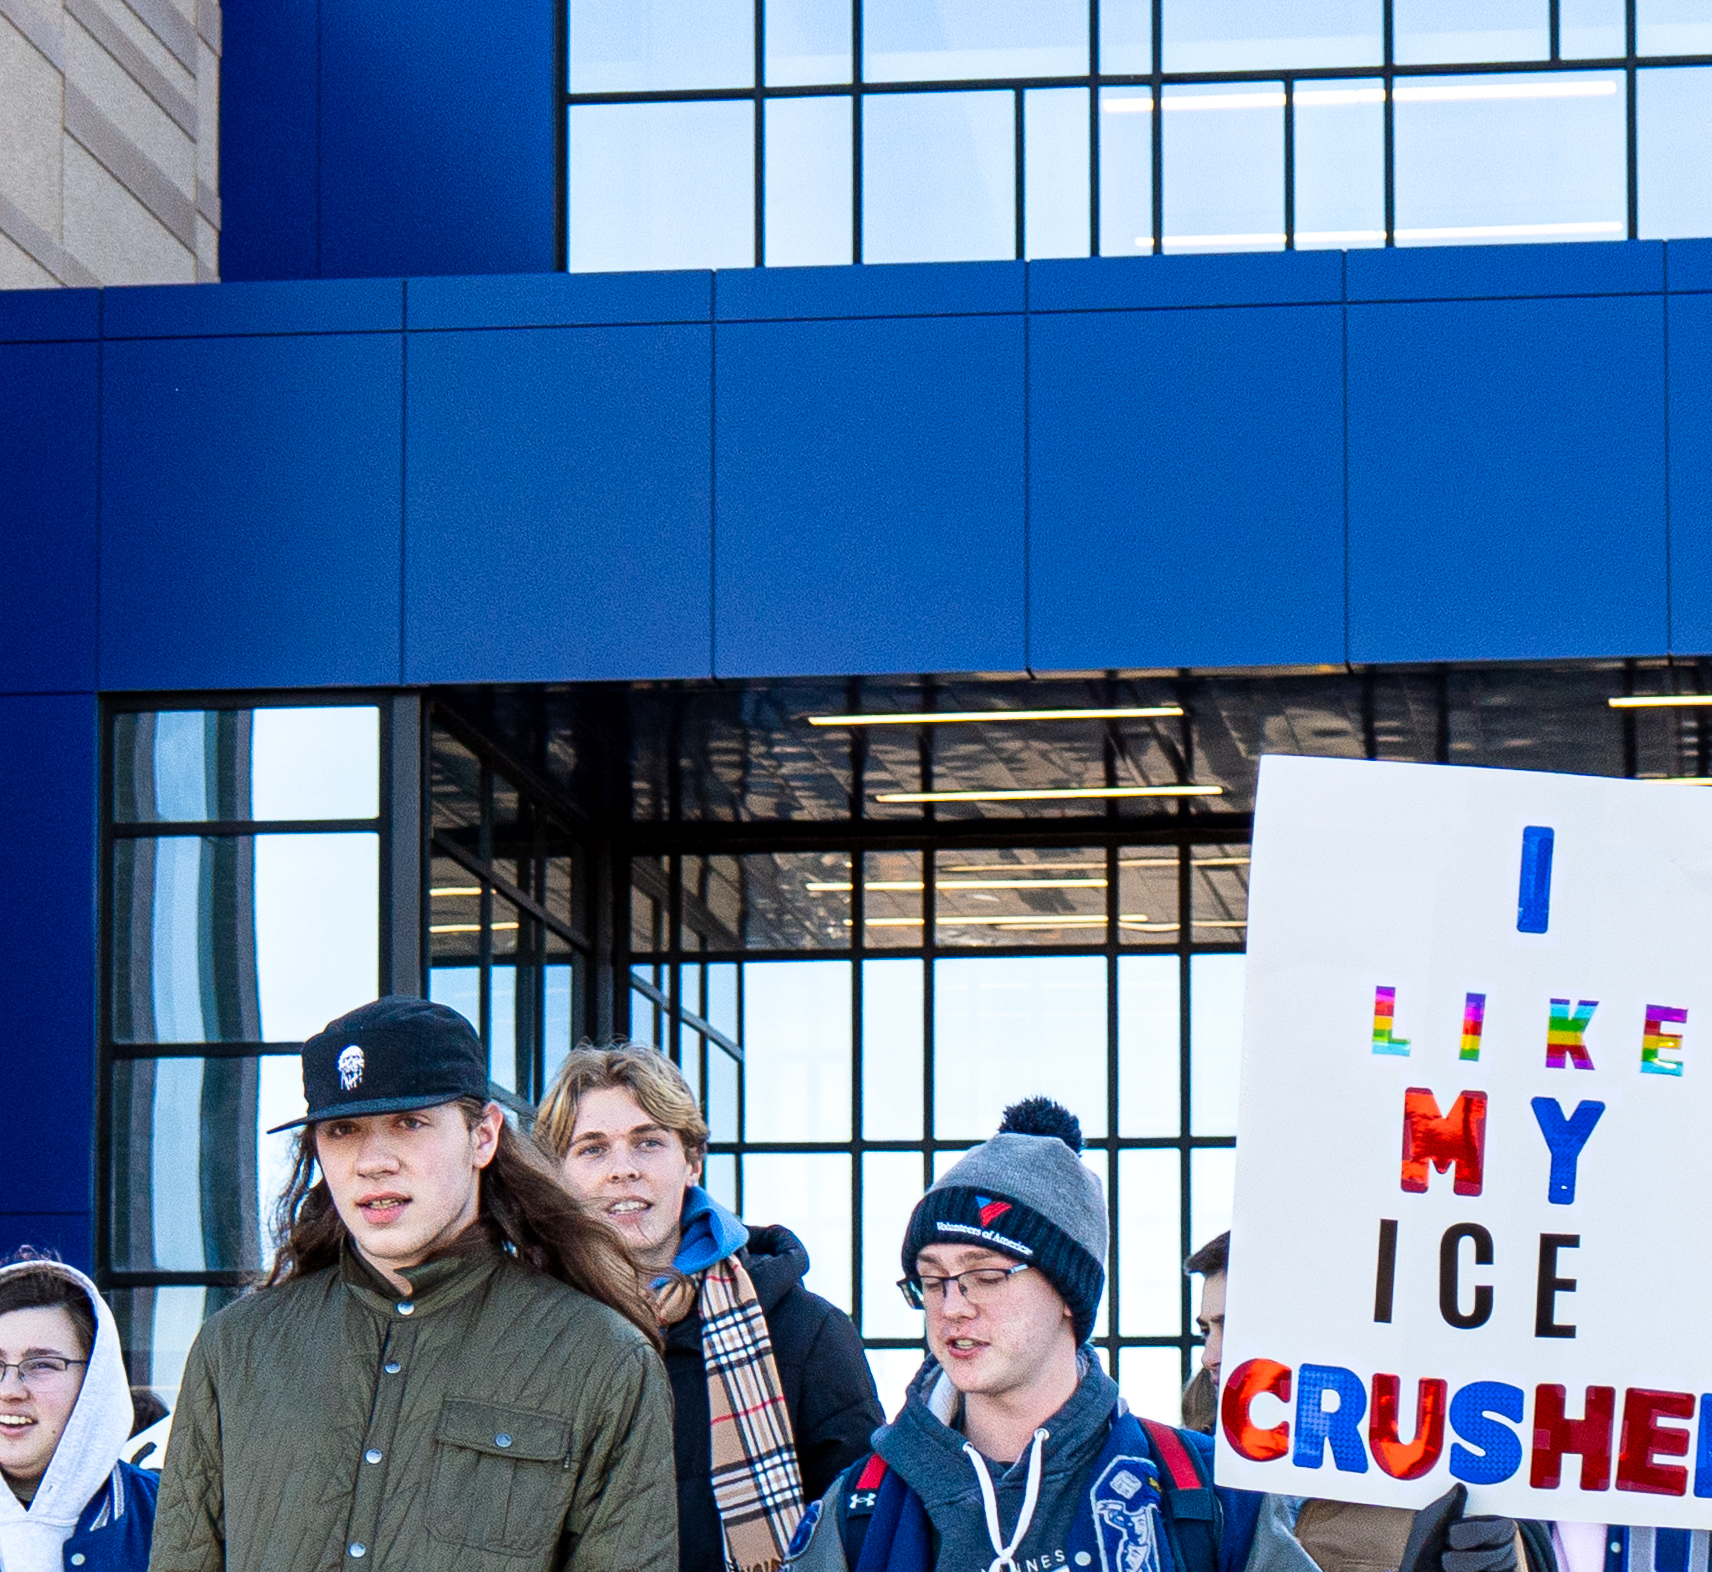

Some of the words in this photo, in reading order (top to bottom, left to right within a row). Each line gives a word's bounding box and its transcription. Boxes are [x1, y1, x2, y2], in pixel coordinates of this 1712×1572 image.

[1516, 825, 1555, 934] I
[1371, 985, 1689, 1077] LIKE
[1400, 1086, 1606, 1205] MY
[936, 1221, 982, 1236] Volunteers
[982, 1230, 994, 1240] of
[992, 1231, 1034, 1256] America
[1373, 1218, 1581, 1339] ICE
